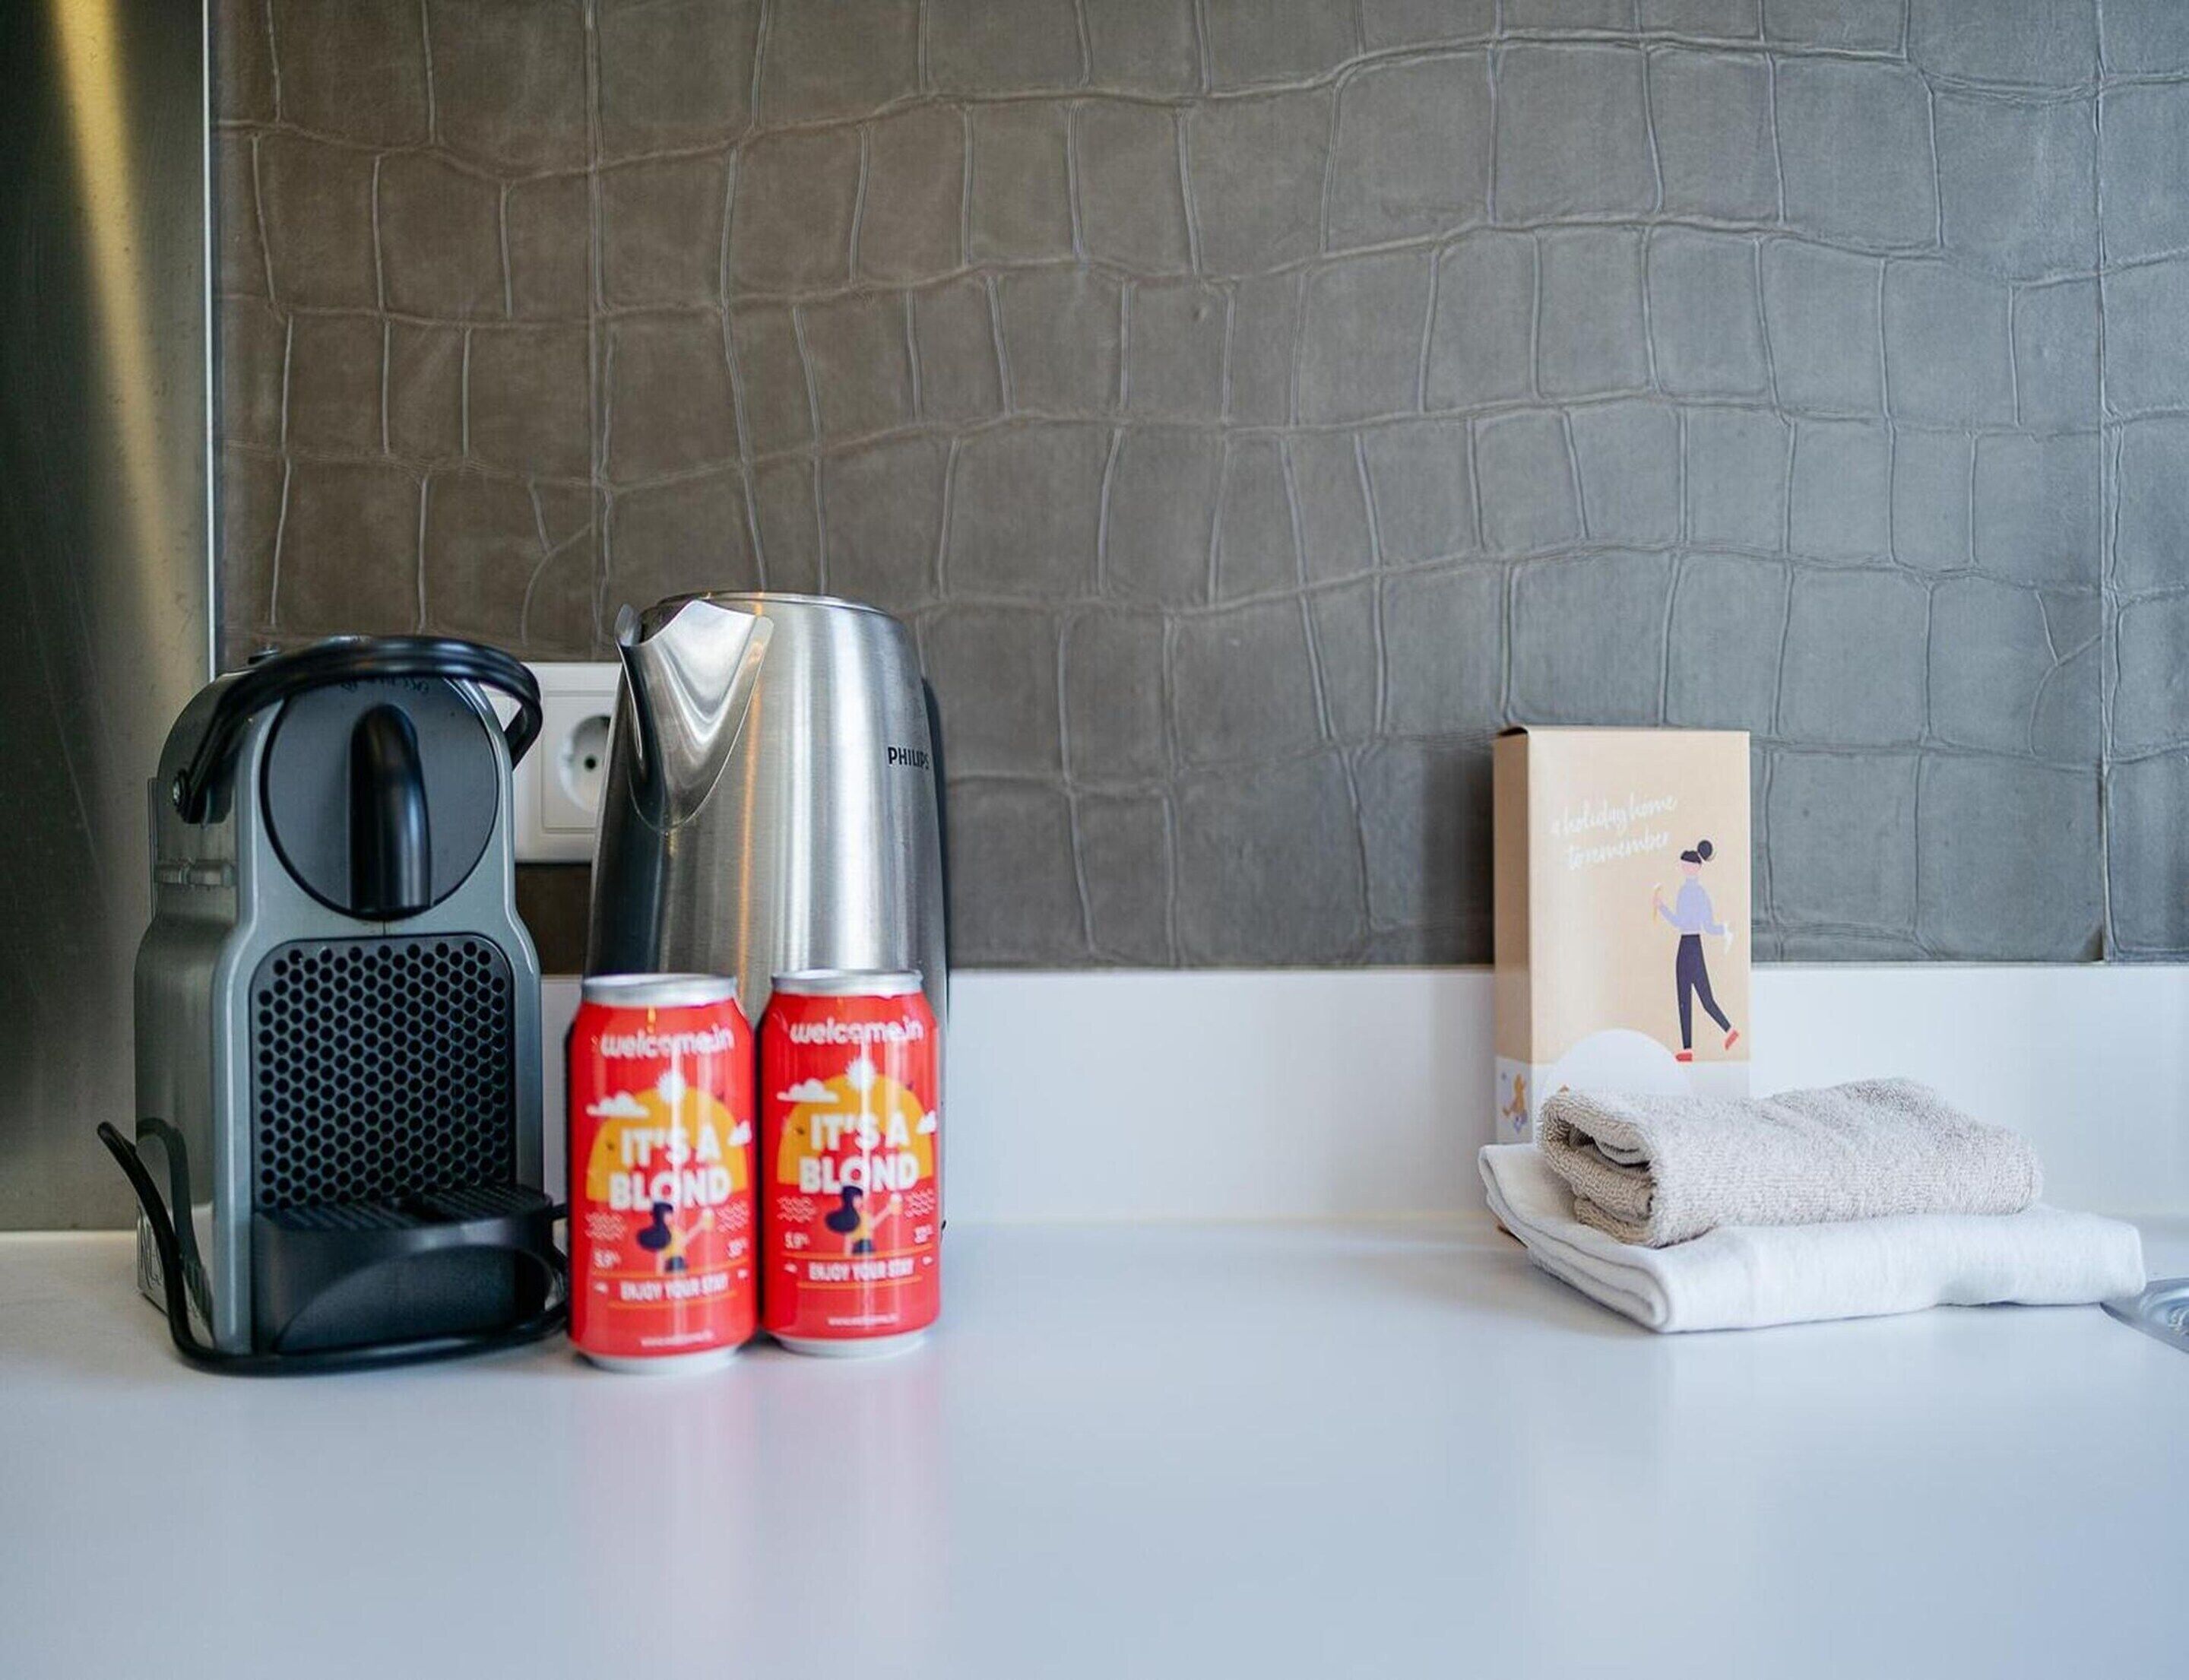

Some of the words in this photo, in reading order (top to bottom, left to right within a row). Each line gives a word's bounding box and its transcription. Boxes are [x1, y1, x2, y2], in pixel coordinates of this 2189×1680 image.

[888, 746, 930, 769] PHILIPS
[1630, 792, 1677, 820] home
[790, 1016, 924, 1044] welcome.in
[621, 1126, 689, 1167] IT'S
[697, 1124, 723, 1162] A
[810, 1114, 879, 1151] IT'S
[885, 1111, 910, 1148] A
[610, 1166, 733, 1211] BLOND
[799, 1153, 920, 1197] BLOND
